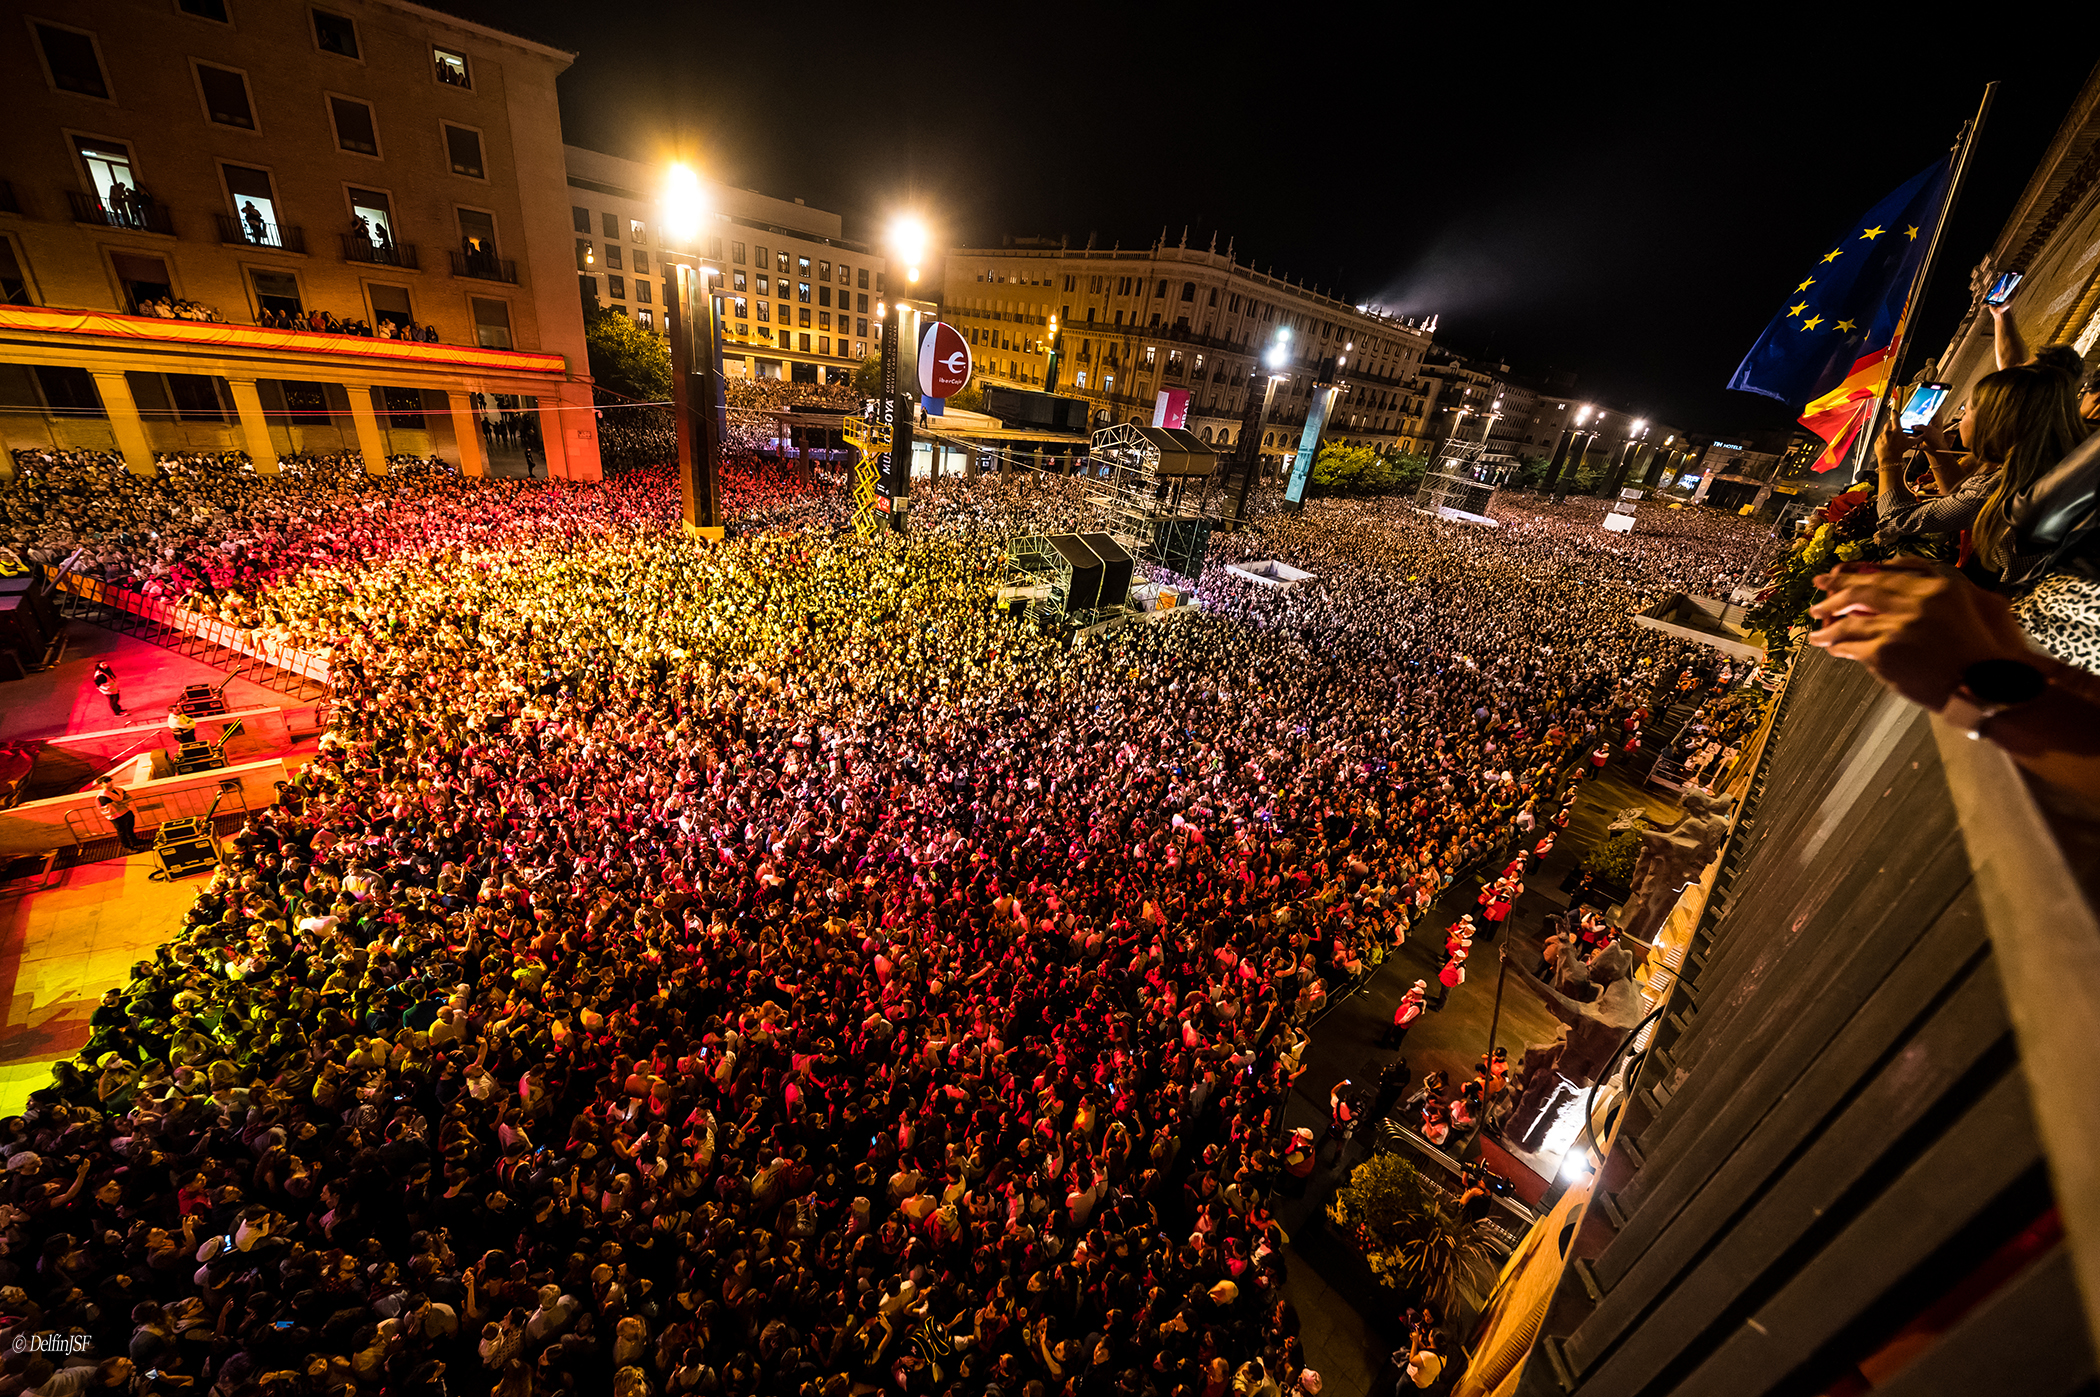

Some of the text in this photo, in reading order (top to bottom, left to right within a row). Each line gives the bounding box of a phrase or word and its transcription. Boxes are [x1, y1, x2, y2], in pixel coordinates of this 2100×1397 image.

[1179, 399, 1189, 429] MBAR
[882, 434, 893, 475] MUSO
[1723, 443, 1743, 451] HOTELS
